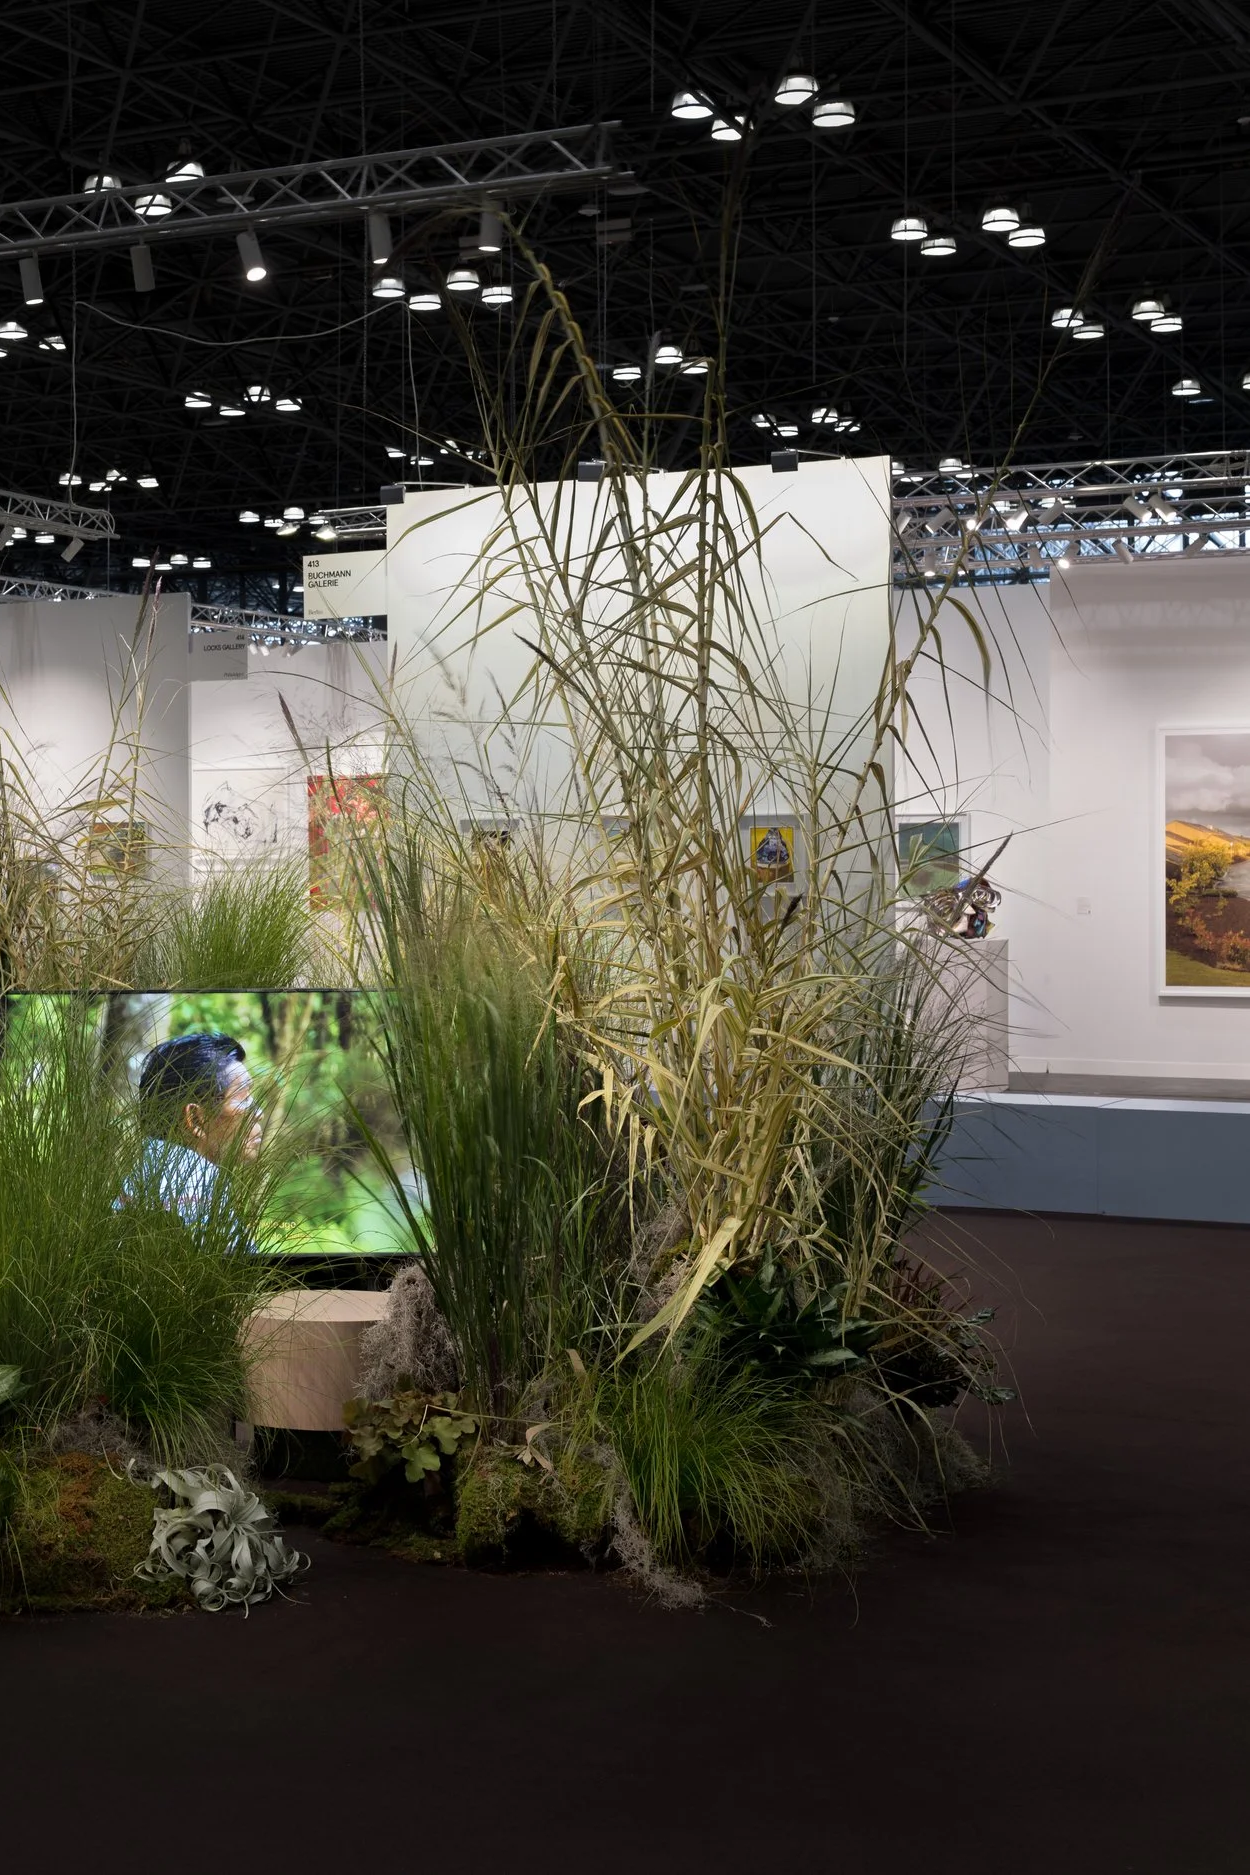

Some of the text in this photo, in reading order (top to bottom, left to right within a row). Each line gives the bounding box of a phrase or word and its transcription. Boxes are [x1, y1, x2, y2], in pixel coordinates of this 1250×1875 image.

[307, 560, 320, 568] 413
[308, 570, 352, 580] BUCHMANN
[308, 579, 339, 588] GALERIE
